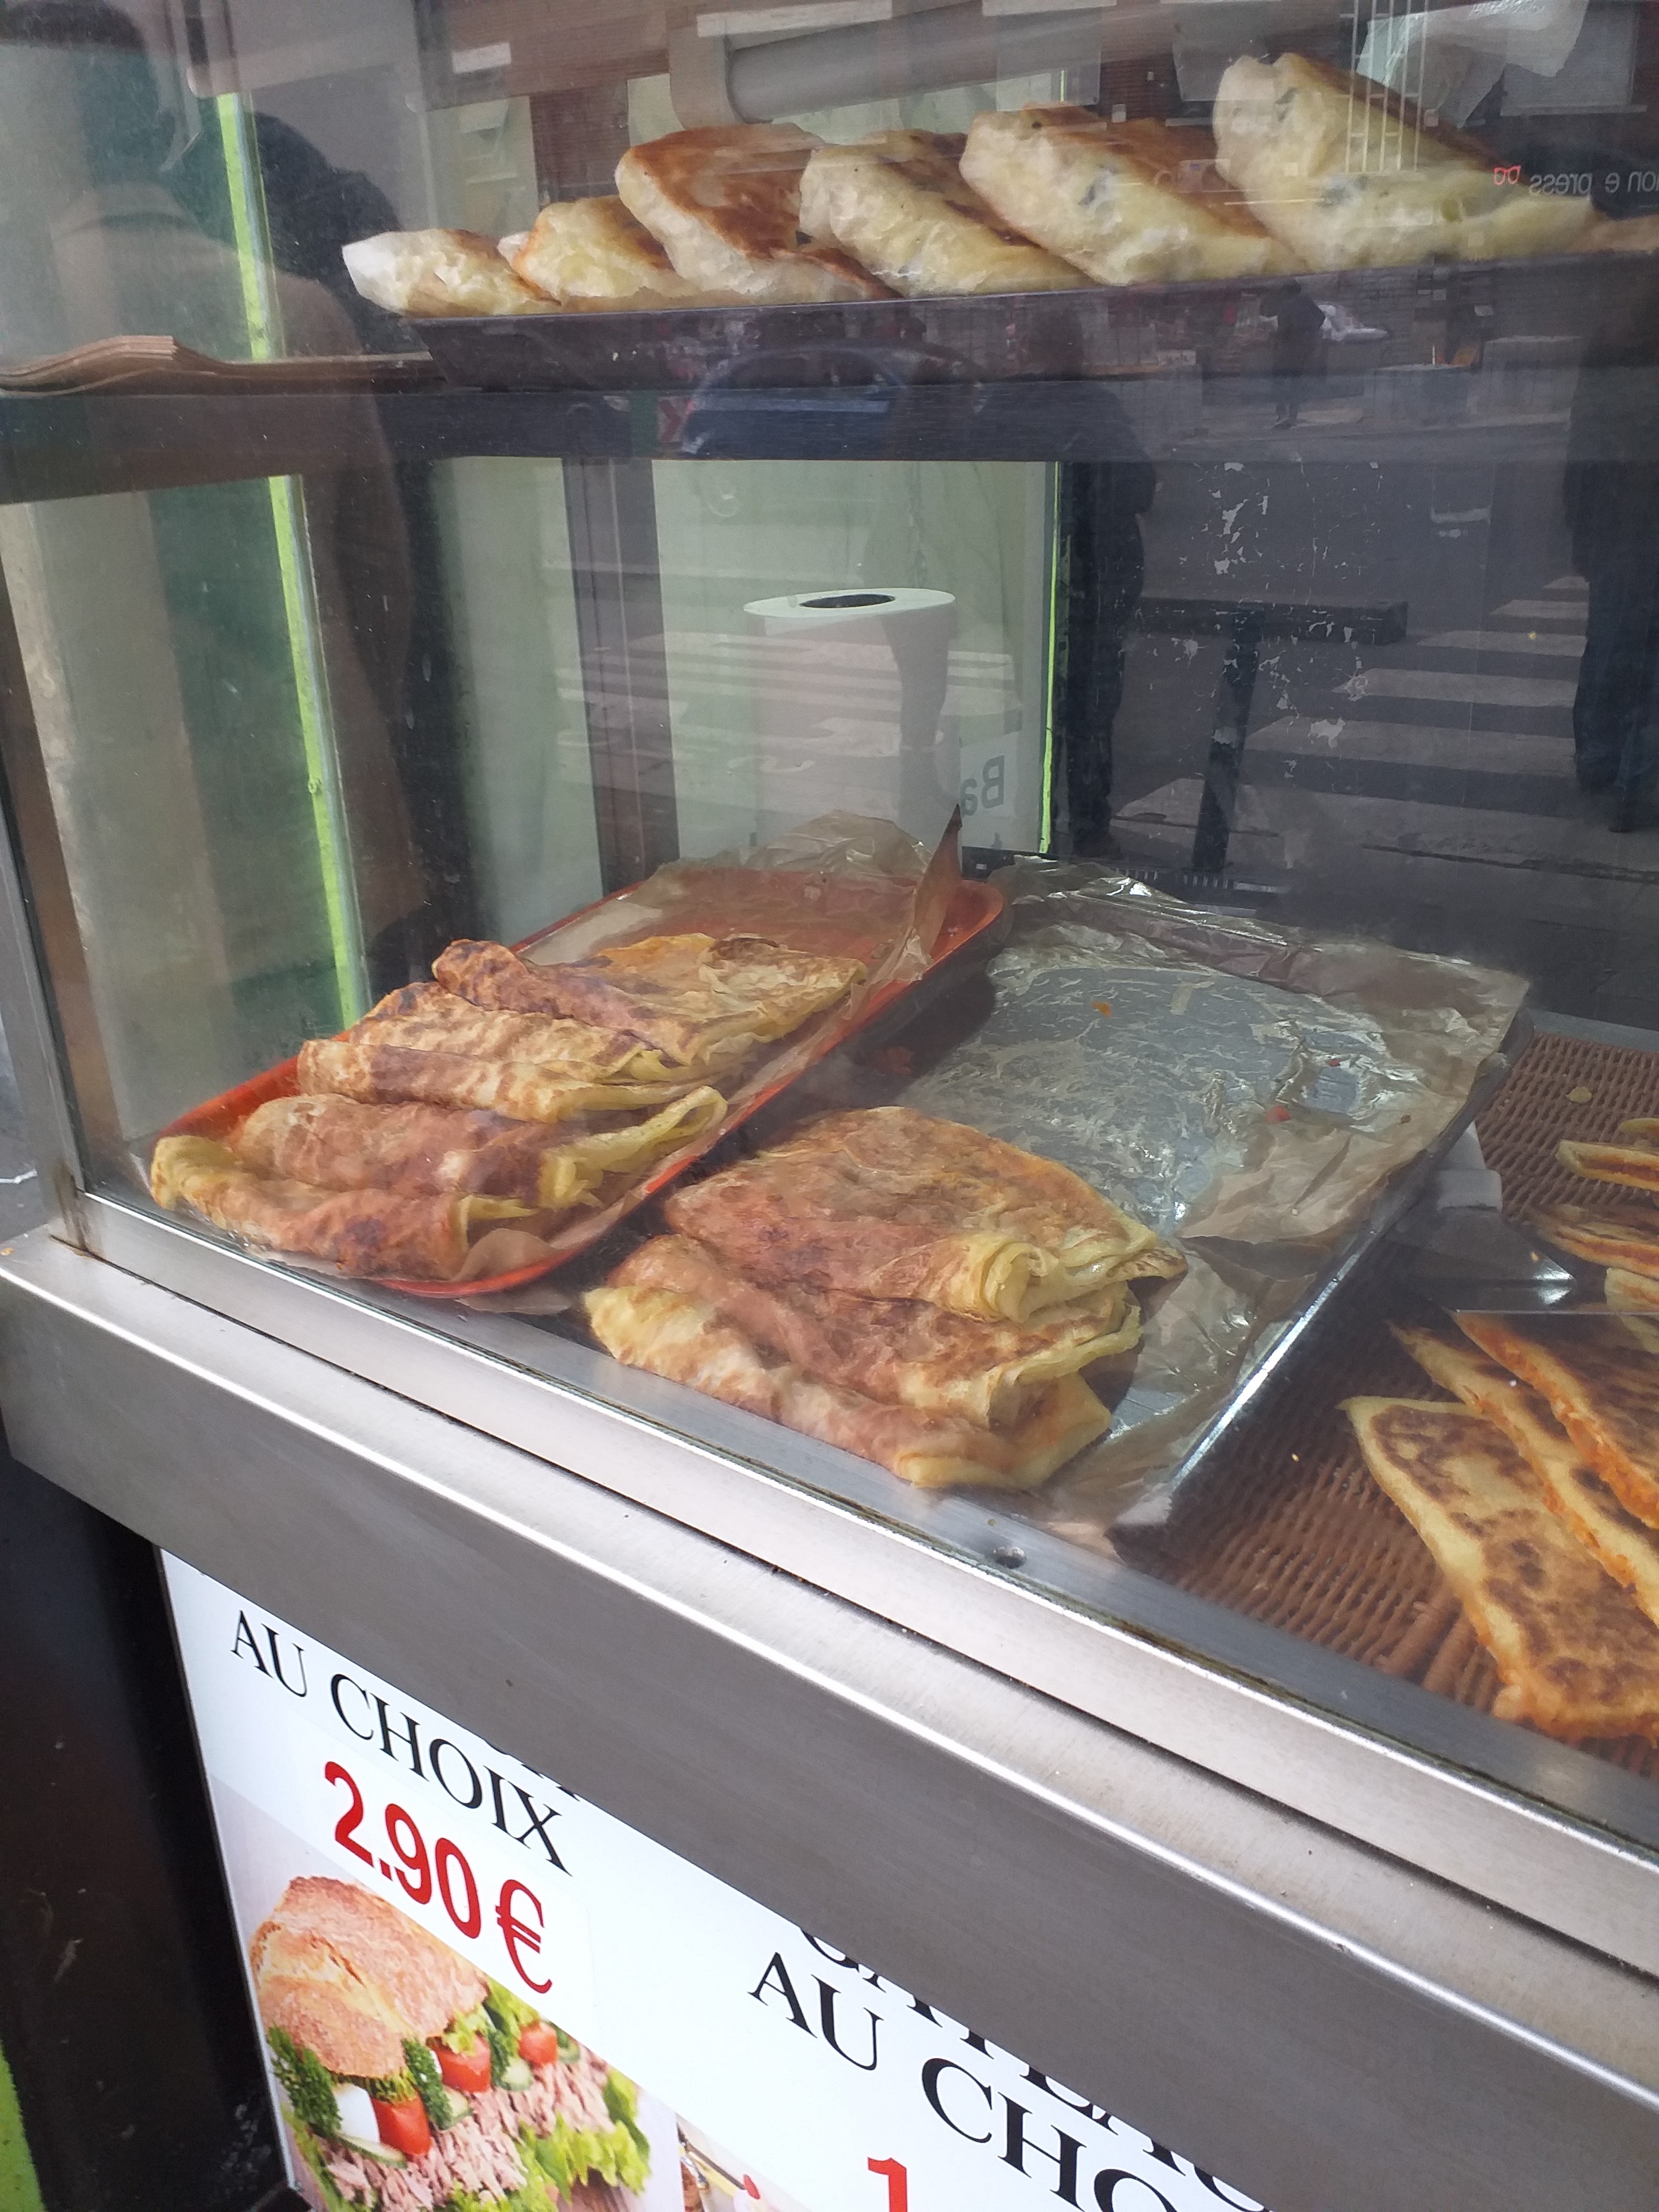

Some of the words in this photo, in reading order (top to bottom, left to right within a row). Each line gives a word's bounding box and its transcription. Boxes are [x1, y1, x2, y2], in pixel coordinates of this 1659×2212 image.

[230, 1609, 308, 1698] AU
[331, 1673, 573, 1877] CHOIX
[747, 1952, 884, 2071] AU
